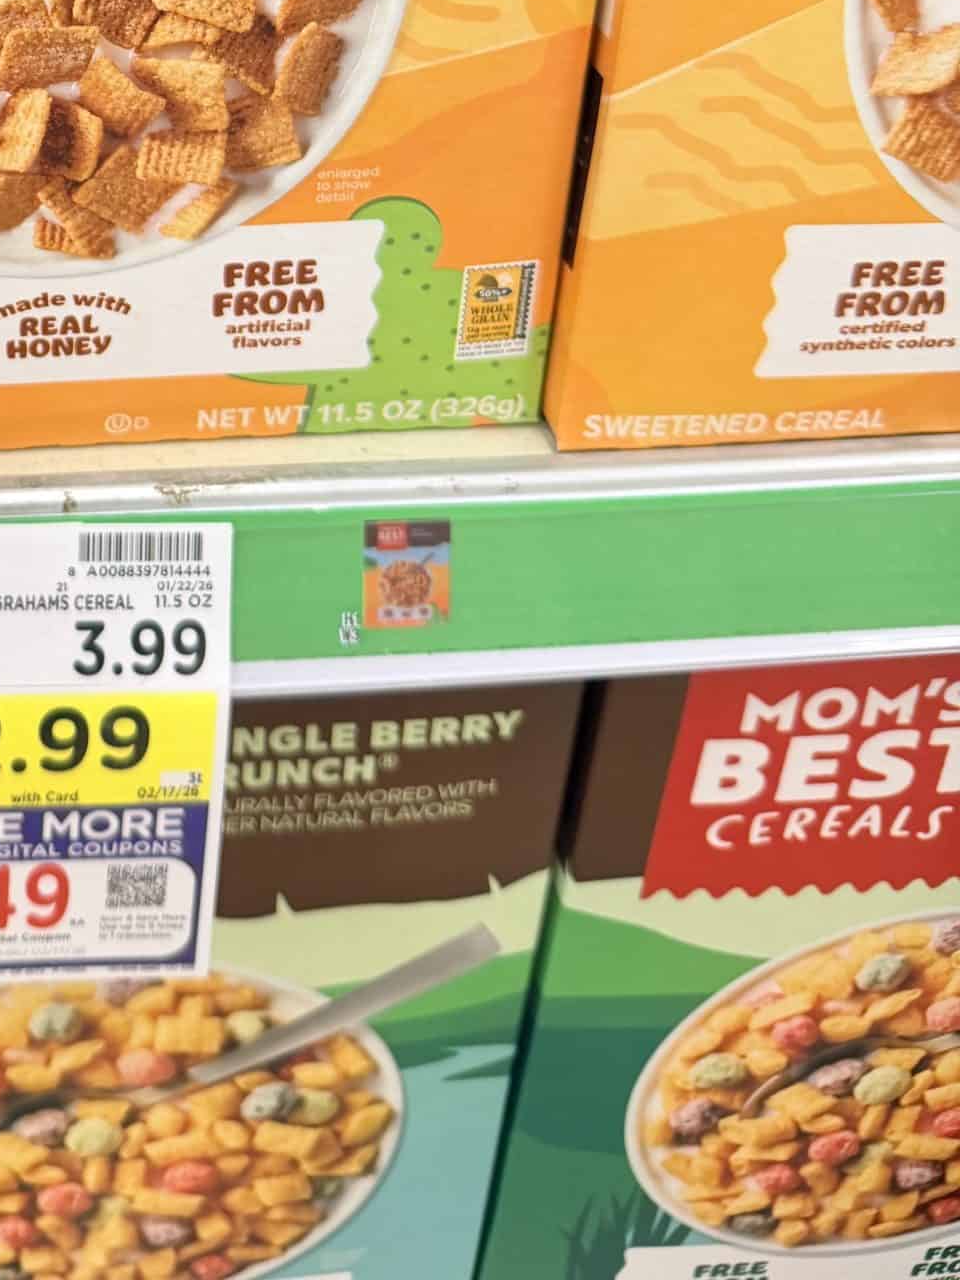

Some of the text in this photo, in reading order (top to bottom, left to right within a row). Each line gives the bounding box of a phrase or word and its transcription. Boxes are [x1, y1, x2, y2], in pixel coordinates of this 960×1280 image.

[223, 259, 318, 288] FREE
[851, 260, 945, 288] FREE
[72, 292, 132, 316] with
[212, 289, 325, 318] FROM
[470, 304, 514, 315] WHOLE
[834, 290, 945, 318] FROM
[19, 314, 99, 337] REAL
[224, 319, 311, 334] artificial
[471, 313, 510, 324] GRAIN
[839, 320, 926, 335] certified
[5, 334, 112, 360] HONEY
[232, 334, 302, 350] flavors
[799, 335, 957, 354] synthetic colors
[196, 393, 526, 431] NET WT 11.5 OZ (326g)
[583, 408, 887, 441] SWEETENED CEREAL
[74, 594, 135, 611] CEREAL
[154, 594, 183, 609] 11.5
[188, 593, 214, 609] OZ
[73, 619, 208, 677] 3.99
[231, 709, 525, 758] NGLE BERRY
[11, 789, 79, 804] with Card
[224, 777, 498, 815] URALLY FLAVORED WITH
[42, 808, 185, 842] MORE
[260, 810, 365, 833] NATURAL
[370, 797, 475, 825] FLAVORS
[704, 803, 955, 850] CEREALS
[67, 837, 183, 858] COUPONS
[693, 1261, 769, 1278] FREE
[911, 1261, 960, 1276] FRO
